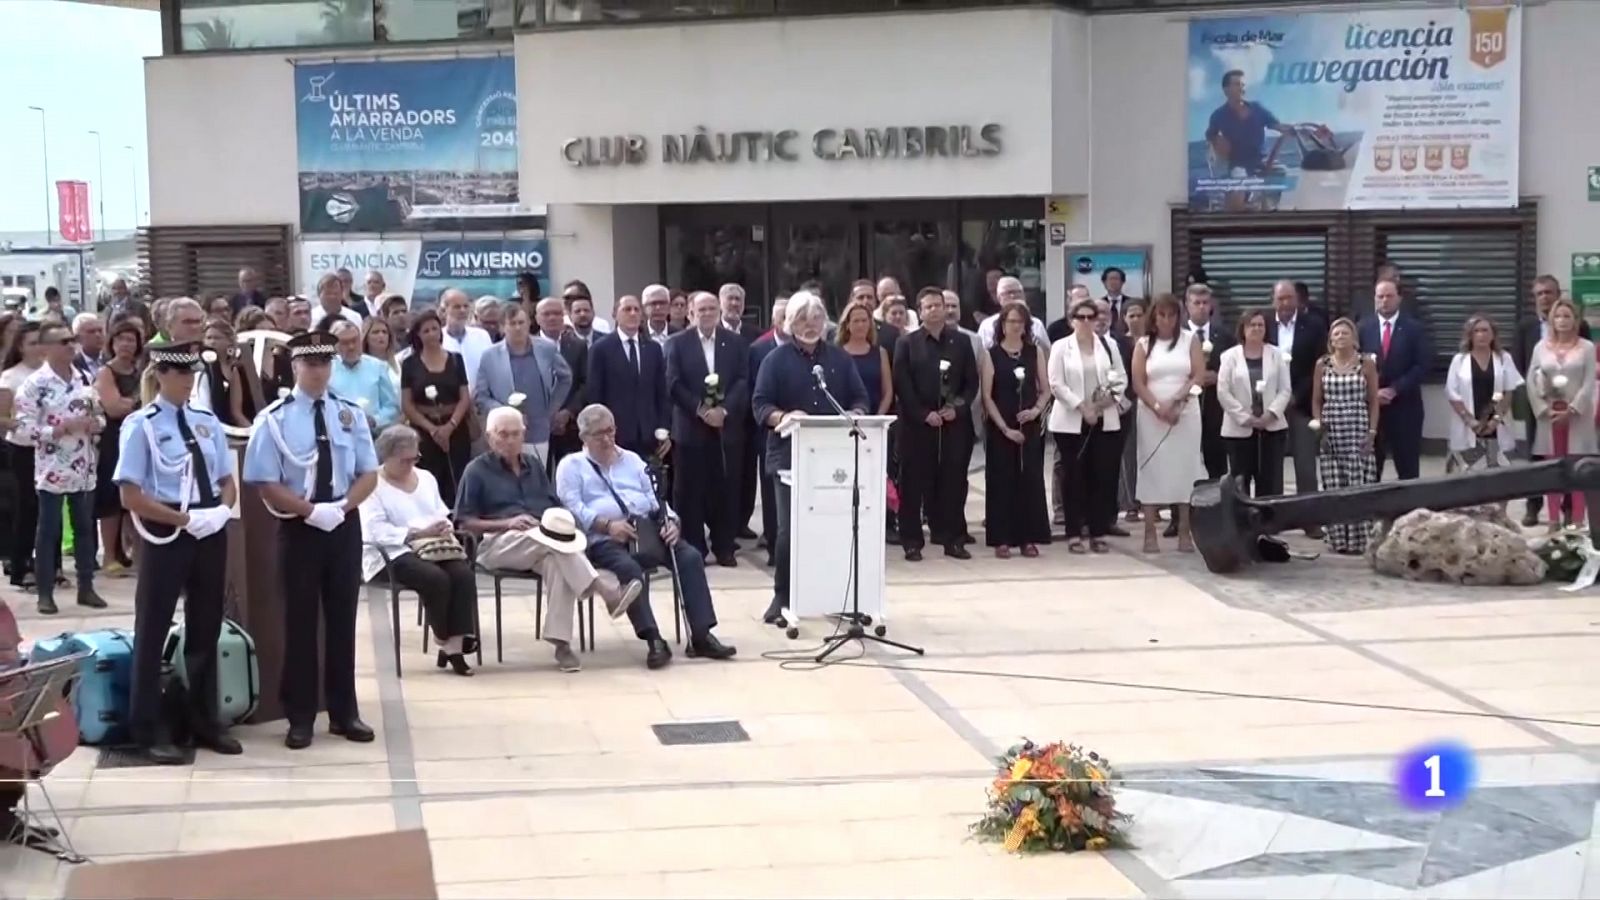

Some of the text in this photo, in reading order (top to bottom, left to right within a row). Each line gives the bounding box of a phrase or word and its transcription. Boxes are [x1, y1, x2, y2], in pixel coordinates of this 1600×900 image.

[1345, 21, 1453, 49] licencia
[1475, 32, 1502, 52] 150
[1265, 49, 1449, 92] navegación
[330, 91, 401, 112] ÚLTIMS
[330, 109, 456, 127] AMARRADORS
[331, 127, 424, 142] A LA VENDA
[560, 136, 647, 167] CLUB
[812, 123, 1003, 160] CAMBRILS
[310, 253, 408, 270] ESTANCIAS
[450, 251, 543, 269] INVIERNO
